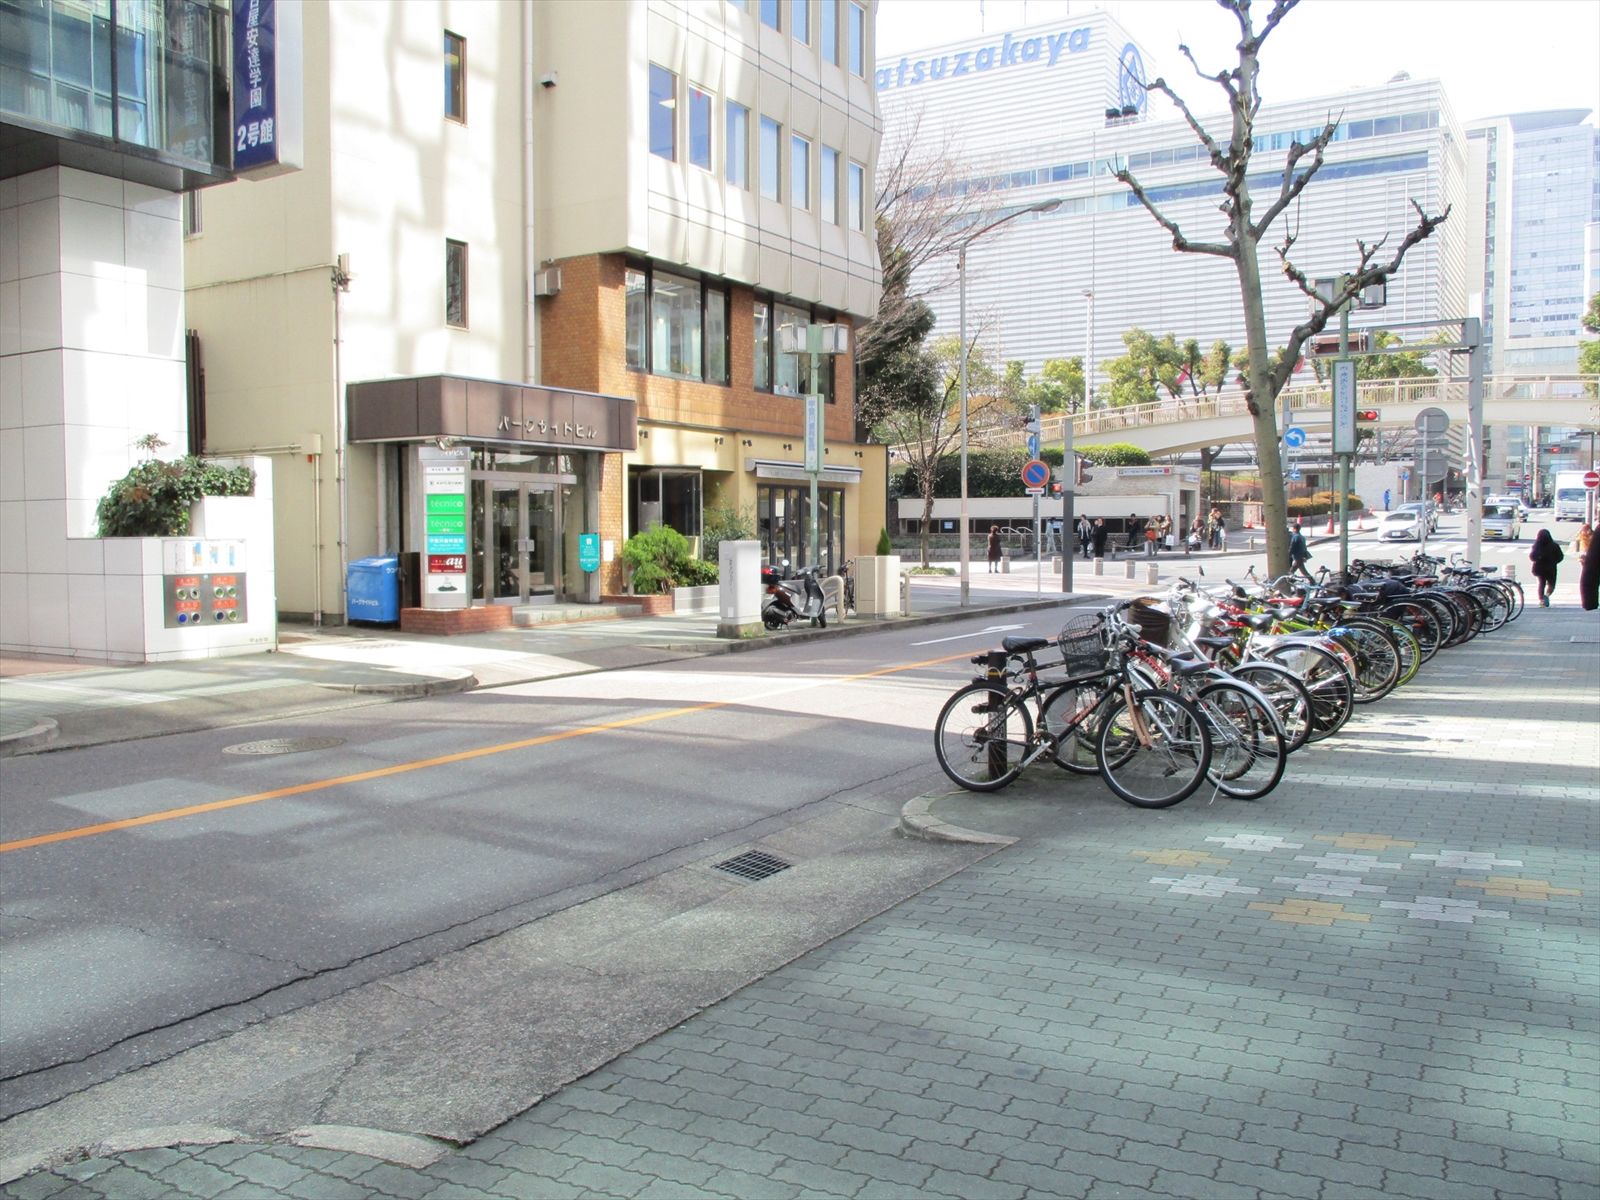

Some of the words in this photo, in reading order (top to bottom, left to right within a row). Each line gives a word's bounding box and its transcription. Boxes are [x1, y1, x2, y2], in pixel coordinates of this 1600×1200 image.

[237, 117, 274, 152] 2号館
[498, 415, 597, 439] パークサイドビル
[446, 557, 463, 566] au
